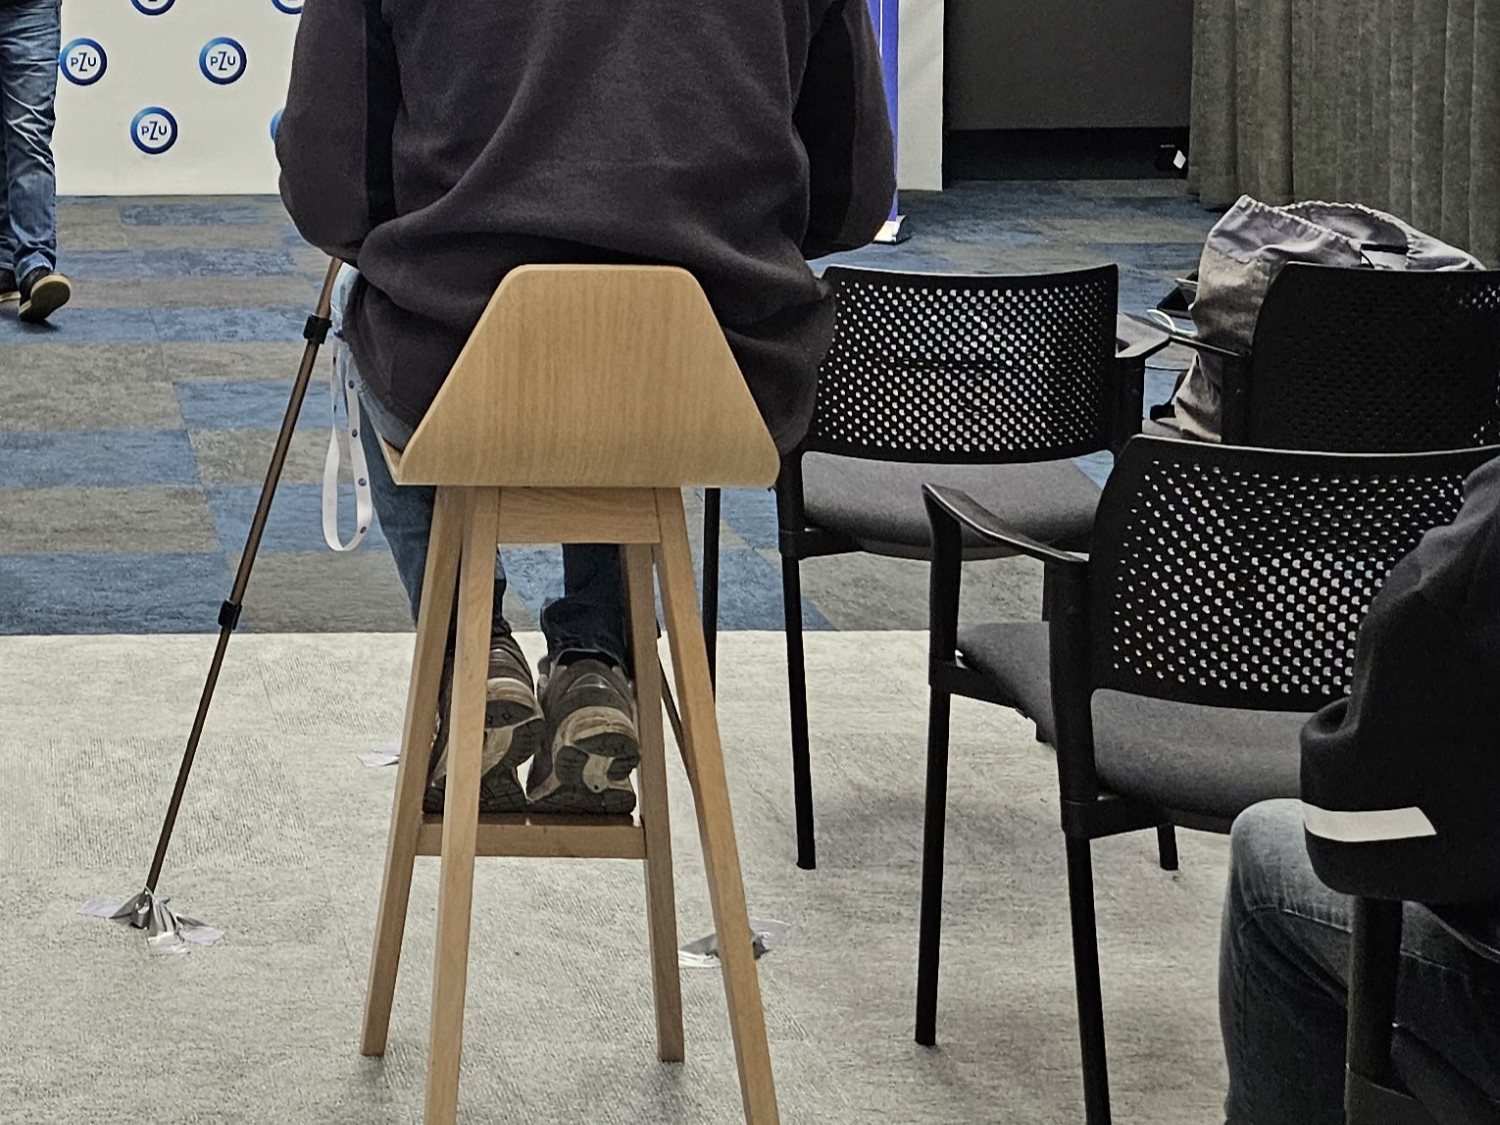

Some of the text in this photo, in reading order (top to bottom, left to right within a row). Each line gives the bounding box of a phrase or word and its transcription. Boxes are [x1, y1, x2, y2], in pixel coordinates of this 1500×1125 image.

[71, 52, 96, 72] PZU
[211, 51, 235, 70] PZU
[142, 121, 167, 140] PZU
